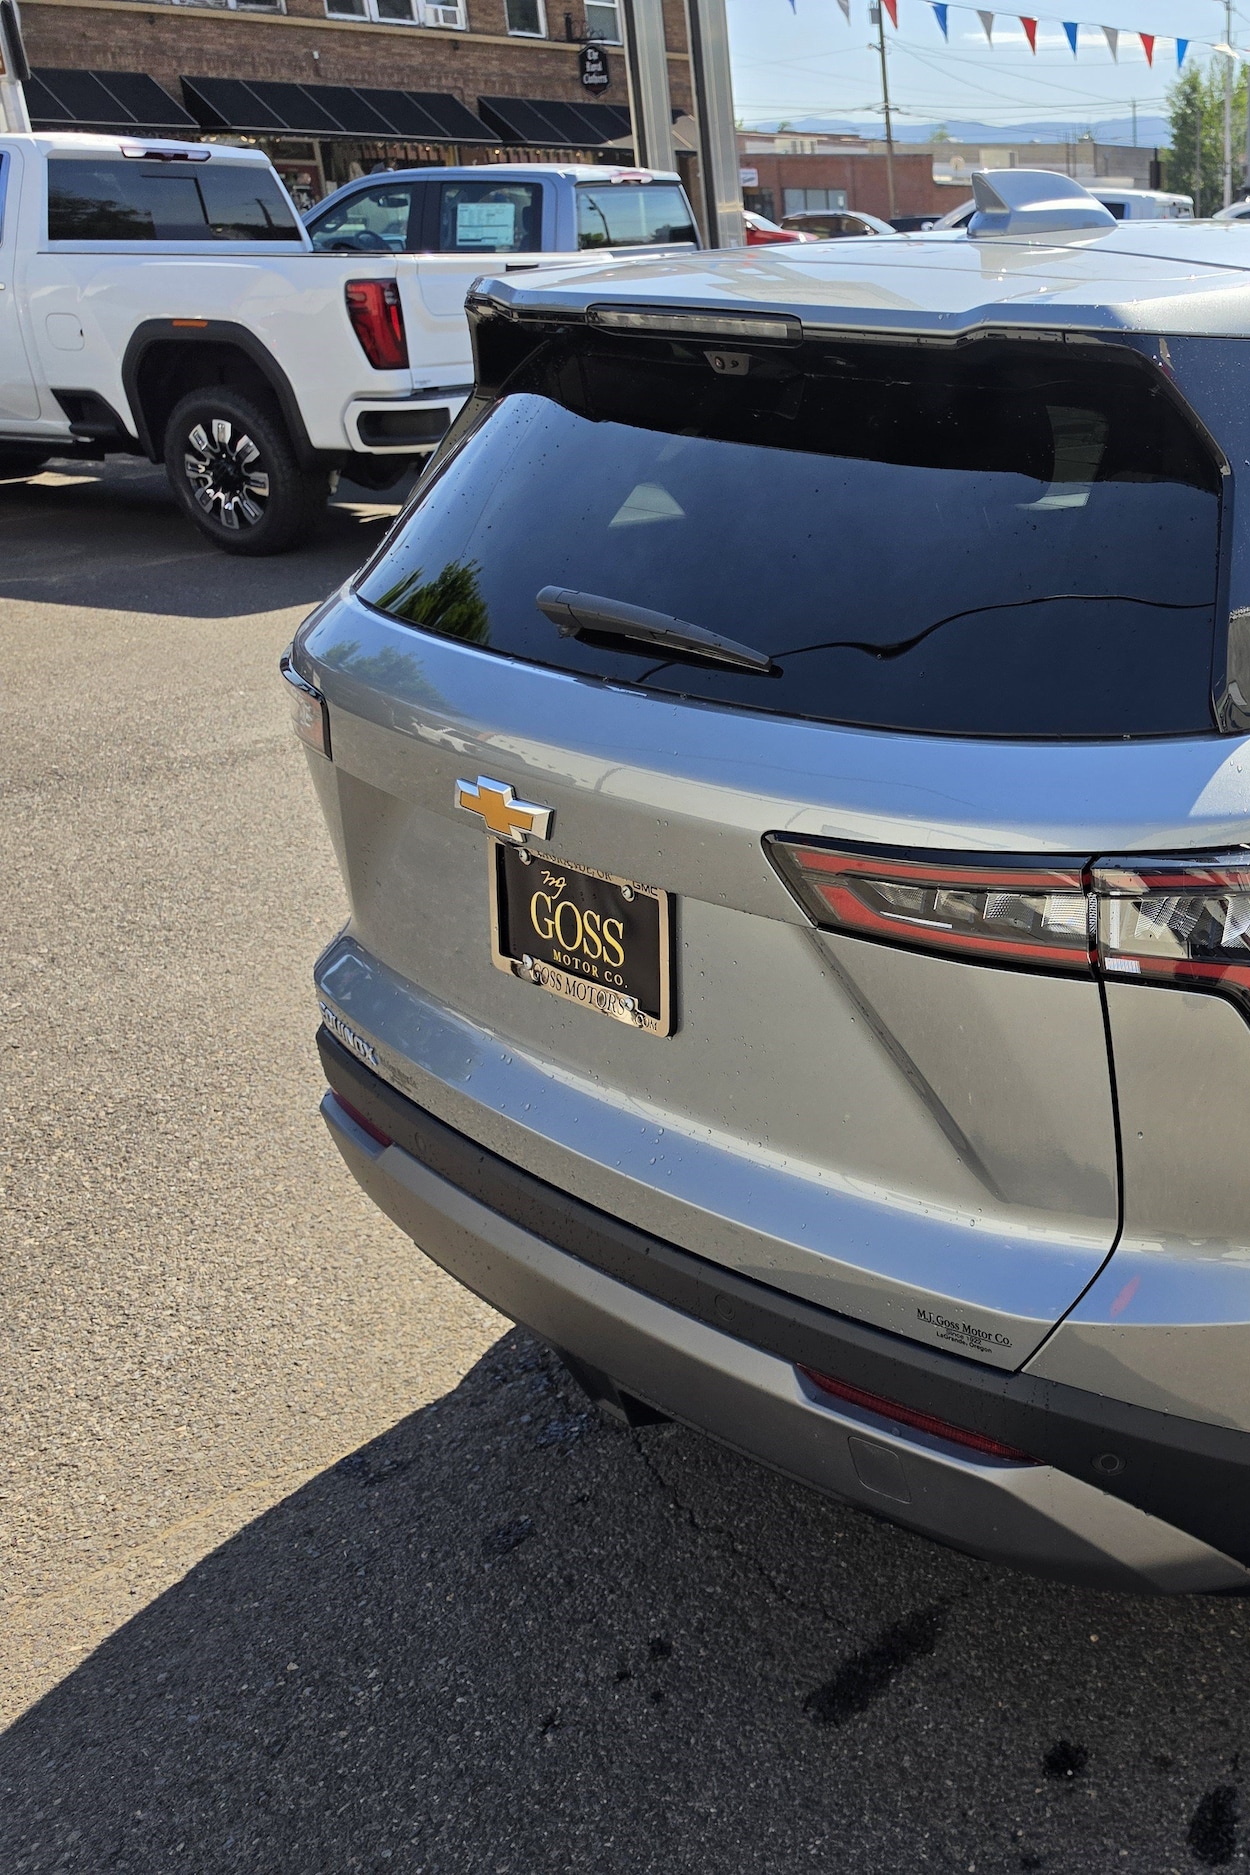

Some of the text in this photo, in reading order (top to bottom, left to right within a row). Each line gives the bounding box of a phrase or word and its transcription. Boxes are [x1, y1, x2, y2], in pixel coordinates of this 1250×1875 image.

[632, 881, 659, 897] GMC
[530, 891, 625, 968] GOSS
[552, 948, 629, 989] MOTOR CO.
[531, 962, 562, 992] GOSS
[564, 977, 626, 1016] MOTORS
[936, 1315, 960, 1331] Goss
[962, 1323, 993, 1341] Motor
[995, 1333, 1013, 1346] Co.
[968, 1341, 993, 1354] Oregon
